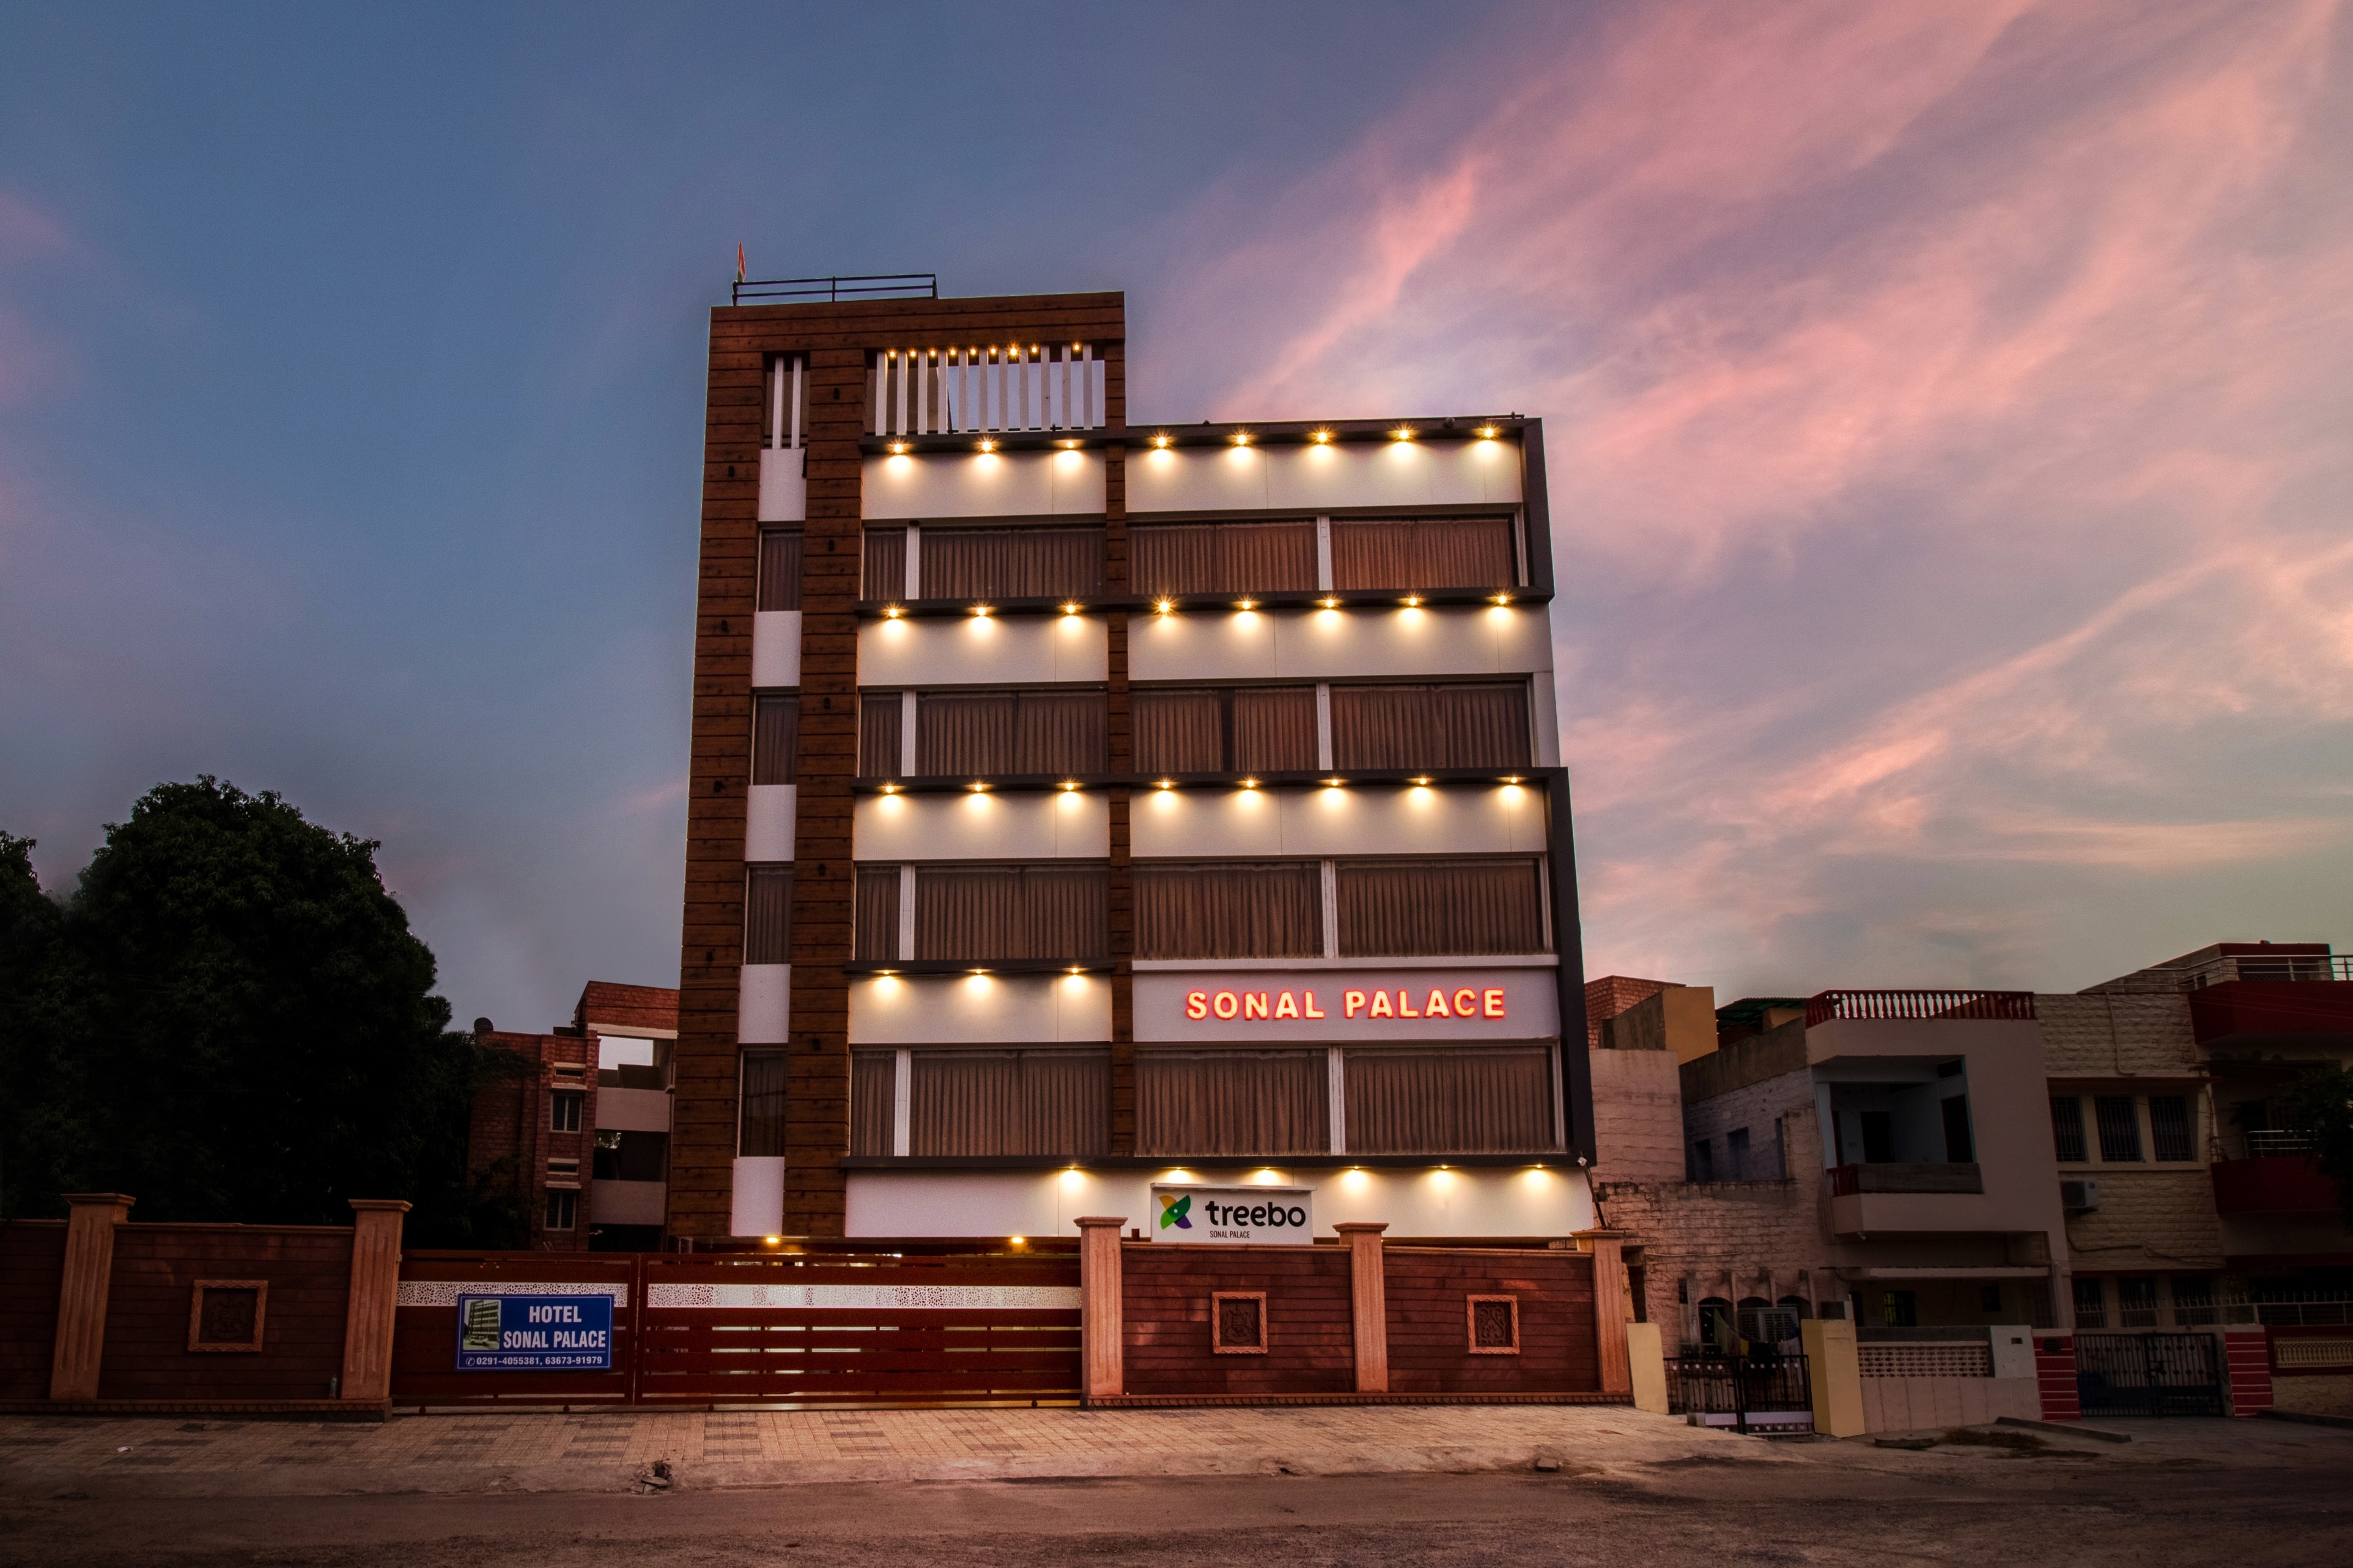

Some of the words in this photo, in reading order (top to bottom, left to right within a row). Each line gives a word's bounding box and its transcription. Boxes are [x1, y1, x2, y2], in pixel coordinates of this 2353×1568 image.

[1186, 991, 1325, 1020] SONAL
[1345, 988, 1505, 1018] PALACE
[1205, 1201, 1306, 1228] treebo
[529, 1306, 582, 1323] HOTEL
[503, 1331, 549, 1348] SONAL
[553, 1330, 606, 1348] PALACE
[476, 1356, 542, 1366] 0291-4055381,
[545, 1356, 602, 1364] 63673-91979
